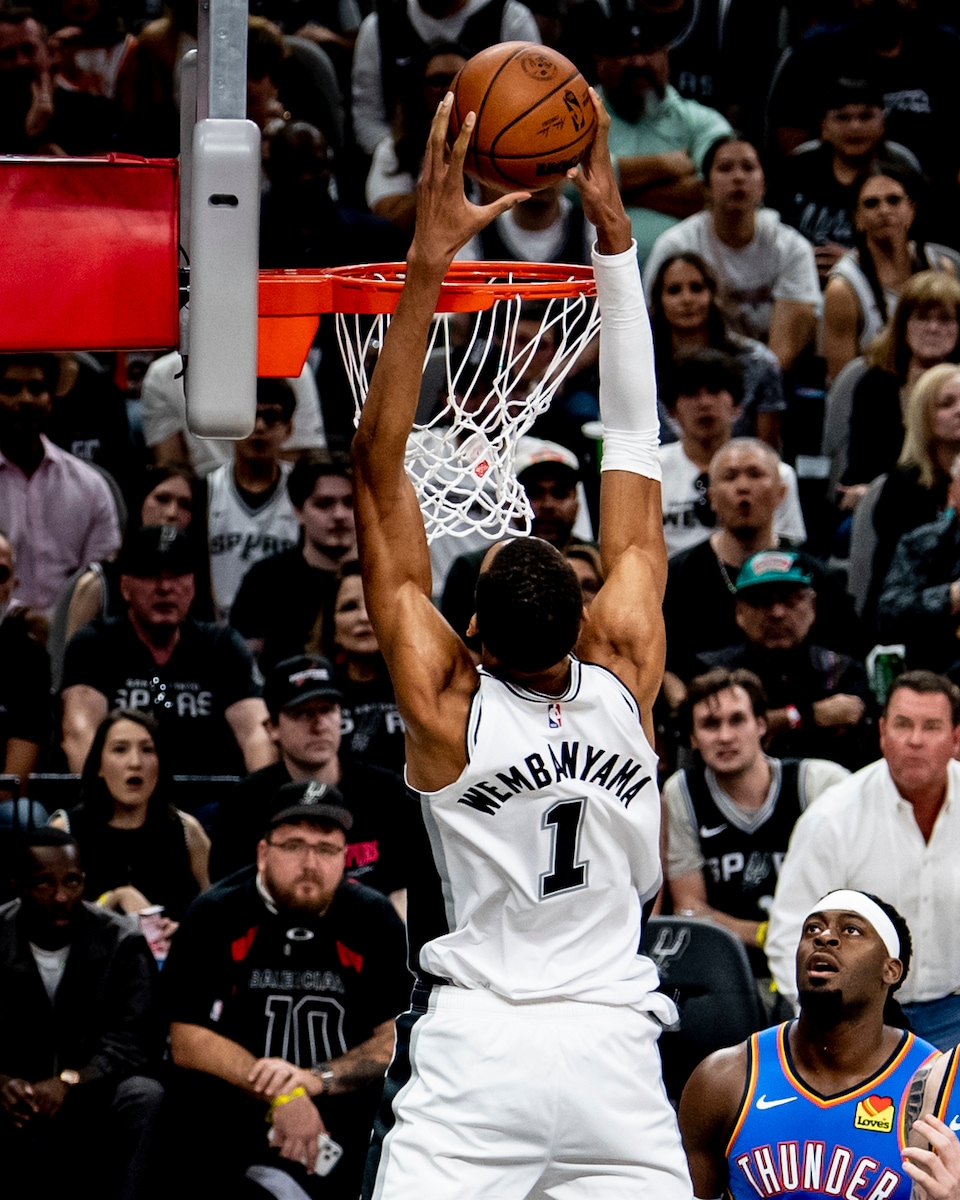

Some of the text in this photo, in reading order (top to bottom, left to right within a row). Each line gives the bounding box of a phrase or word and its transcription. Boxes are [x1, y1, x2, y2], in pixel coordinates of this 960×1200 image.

[457, 741, 652, 816] WEMBANYAMA
[538, 796, 600, 902] 1
[264, 995, 348, 1067] 10
